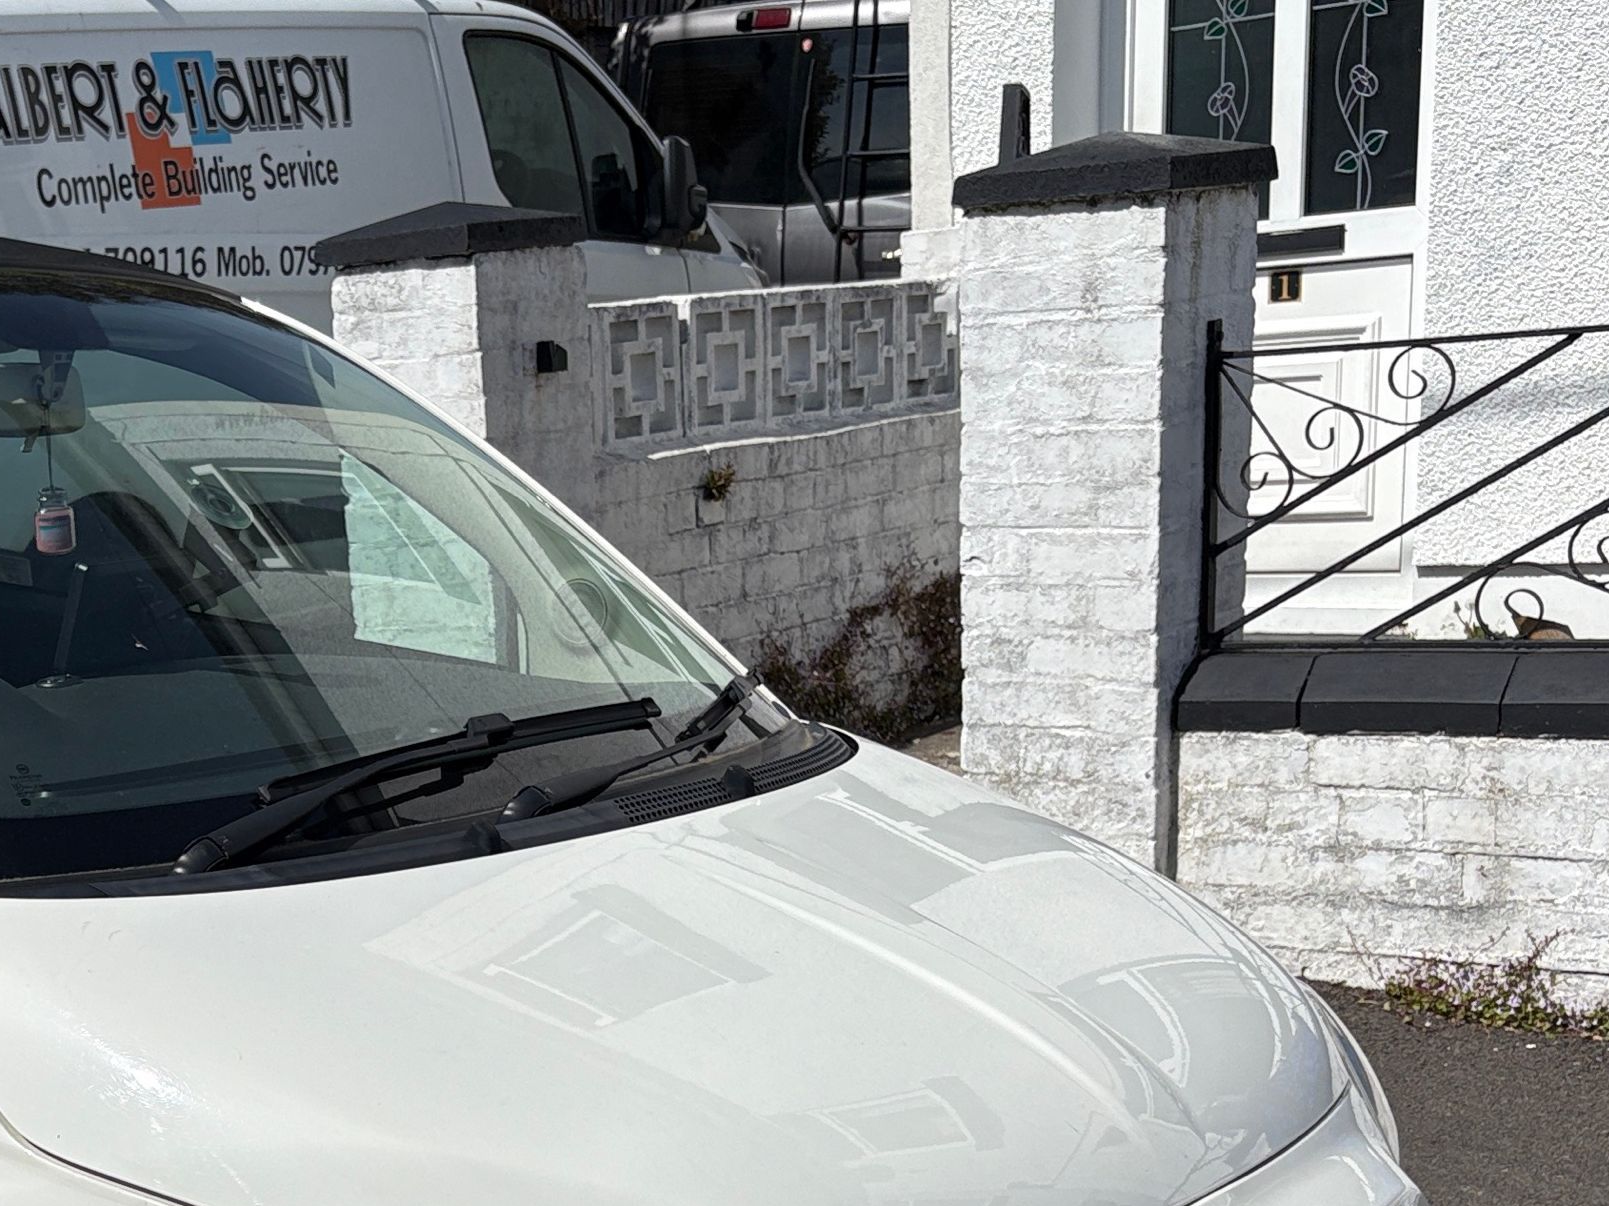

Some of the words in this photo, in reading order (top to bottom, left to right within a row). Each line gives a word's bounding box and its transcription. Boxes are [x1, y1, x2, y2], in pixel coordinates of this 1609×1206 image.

[131, 58, 180, 138] &
[37, 163, 155, 214] Complete
[163, 155, 253, 202] Building
[262, 152, 339, 191] Service
[217, 245, 271, 277] Mob.
[1278, 275, 1292, 300] 1
